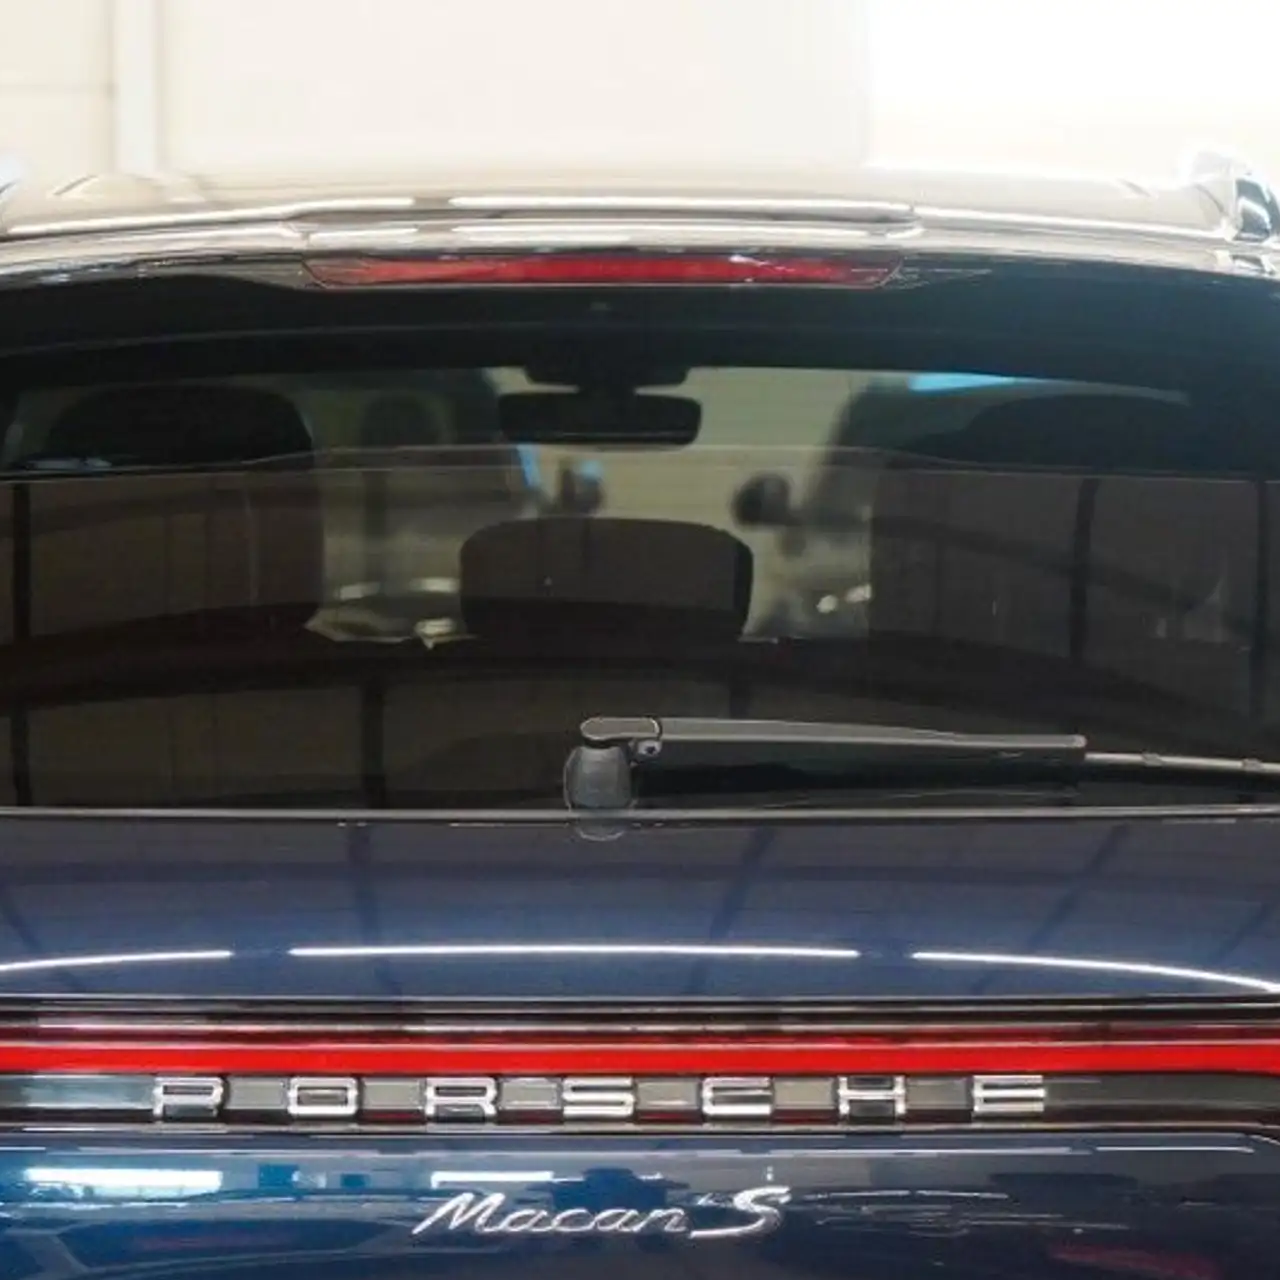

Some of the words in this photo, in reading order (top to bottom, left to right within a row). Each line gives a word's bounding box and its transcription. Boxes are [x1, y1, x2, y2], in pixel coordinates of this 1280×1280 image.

[152, 1073, 1047, 1118] PORSCHE
[411, 1192, 688, 1235] Macan
[688, 1184, 792, 1239] S
